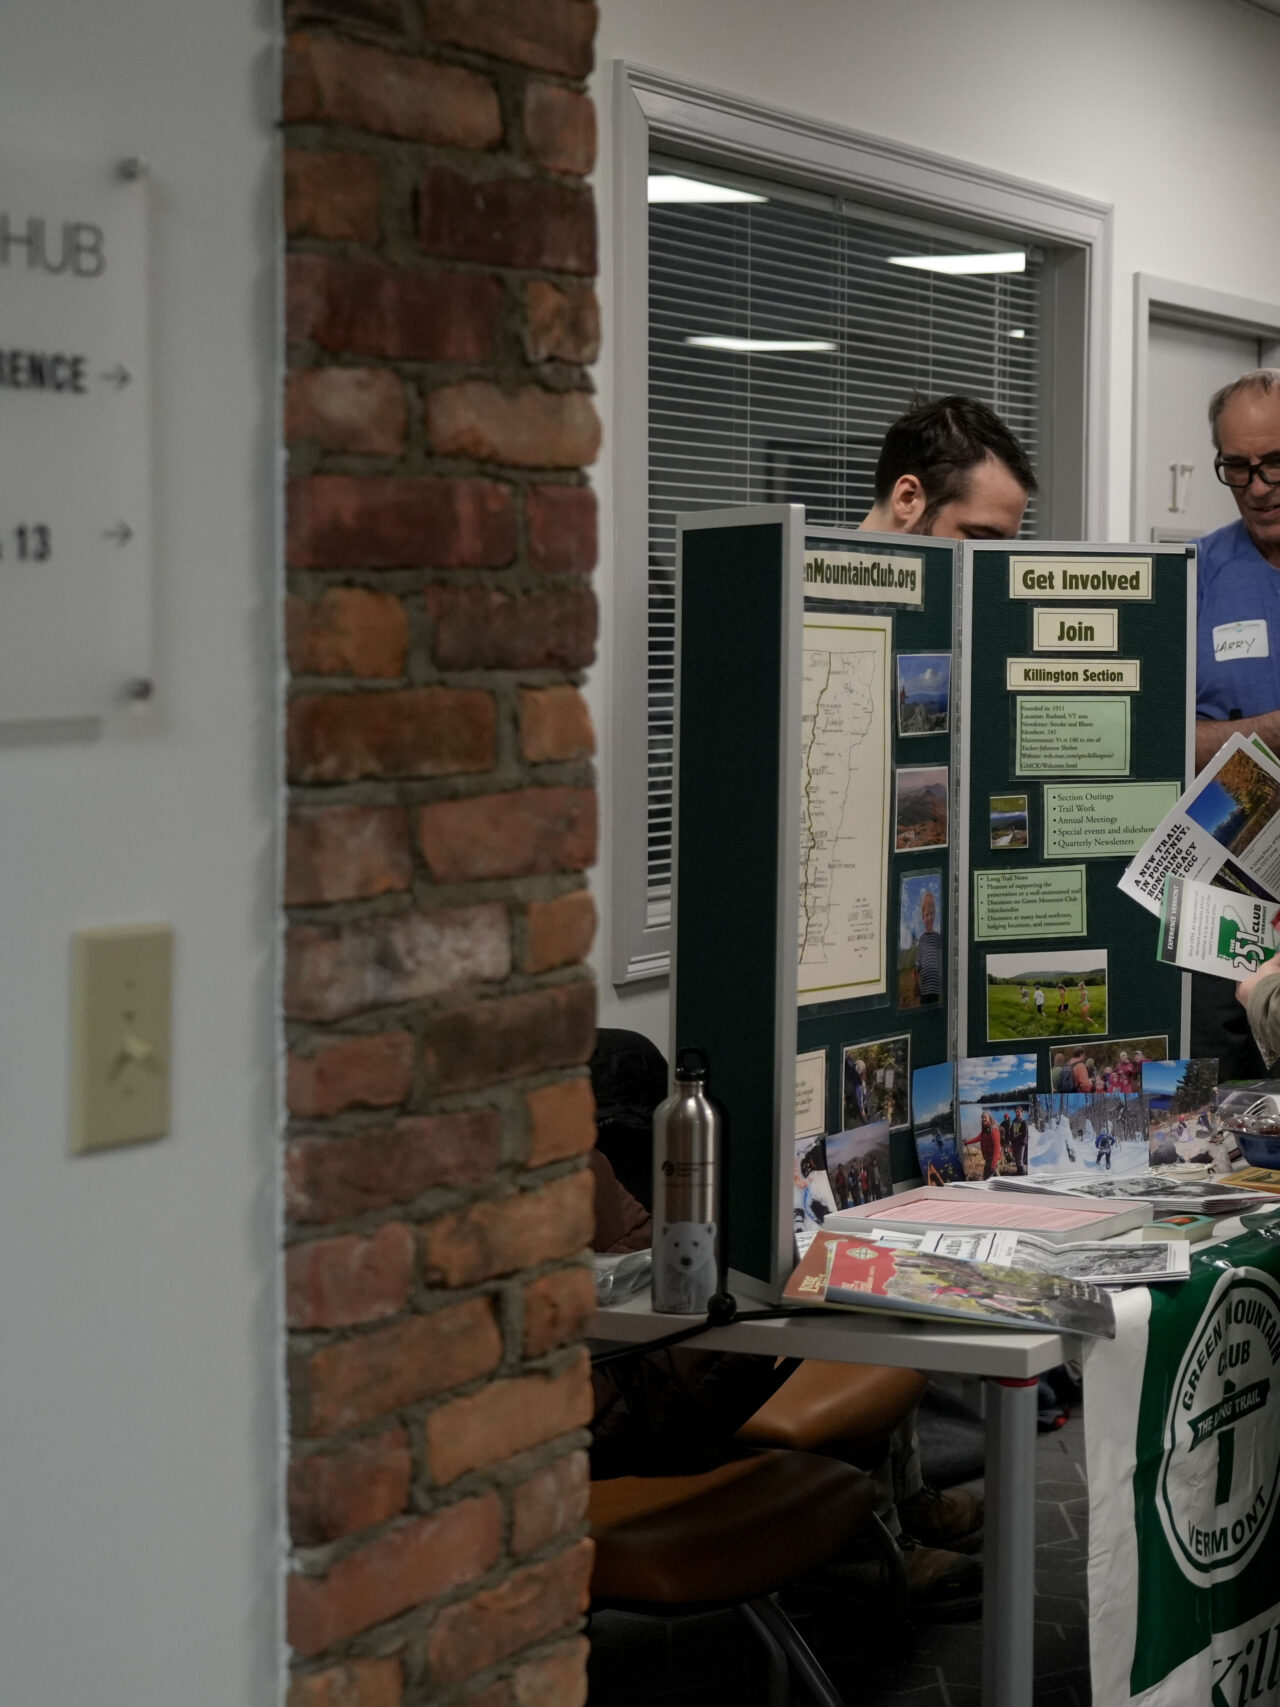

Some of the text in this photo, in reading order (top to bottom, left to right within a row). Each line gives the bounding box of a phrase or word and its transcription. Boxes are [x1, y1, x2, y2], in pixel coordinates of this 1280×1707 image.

[1169, 463, 1194, 513] 17
[15, 523, 51, 563] 13
[804, 557, 916, 592] nMountainClub.org
[1022, 569, 1140, 591] Get Involved
[1057, 621, 1095, 641] Join
[1214, 637, 1256, 654] LARRY
[1023, 669, 1124, 683] Killington Section
[1057, 793, 1114, 803] Section Outings
[1057, 804, 1096, 813] Trail Work
[1057, 816, 1118, 825] Annual Meetings
[1057, 828, 1082, 837] Special
[1057, 838, 1134, 848] Quarterly Newsletters
[1134, 824, 1182, 887] A NEW TRAIL
[1147, 847, 1183, 897] HONORING
[1171, 841, 1197, 876] EGACY
[1183, 855, 1198, 873] CCC
[1140, 880, 1151, 893] IN
[1167, 885, 1180, 950] EXPERIENCE VERMONT
[1233, 904, 1265, 972] 251 CLUB
[1260, 936, 1265, 945] OF
[1182, 1320, 1222, 1411] GREEN
[1217, 1340, 1251, 1377] CUB
[1197, 1415, 1214, 1438] THE
[1234, 1389, 1261, 1413] TRAIL
[1188, 1484, 1266, 1557] VERMONT
